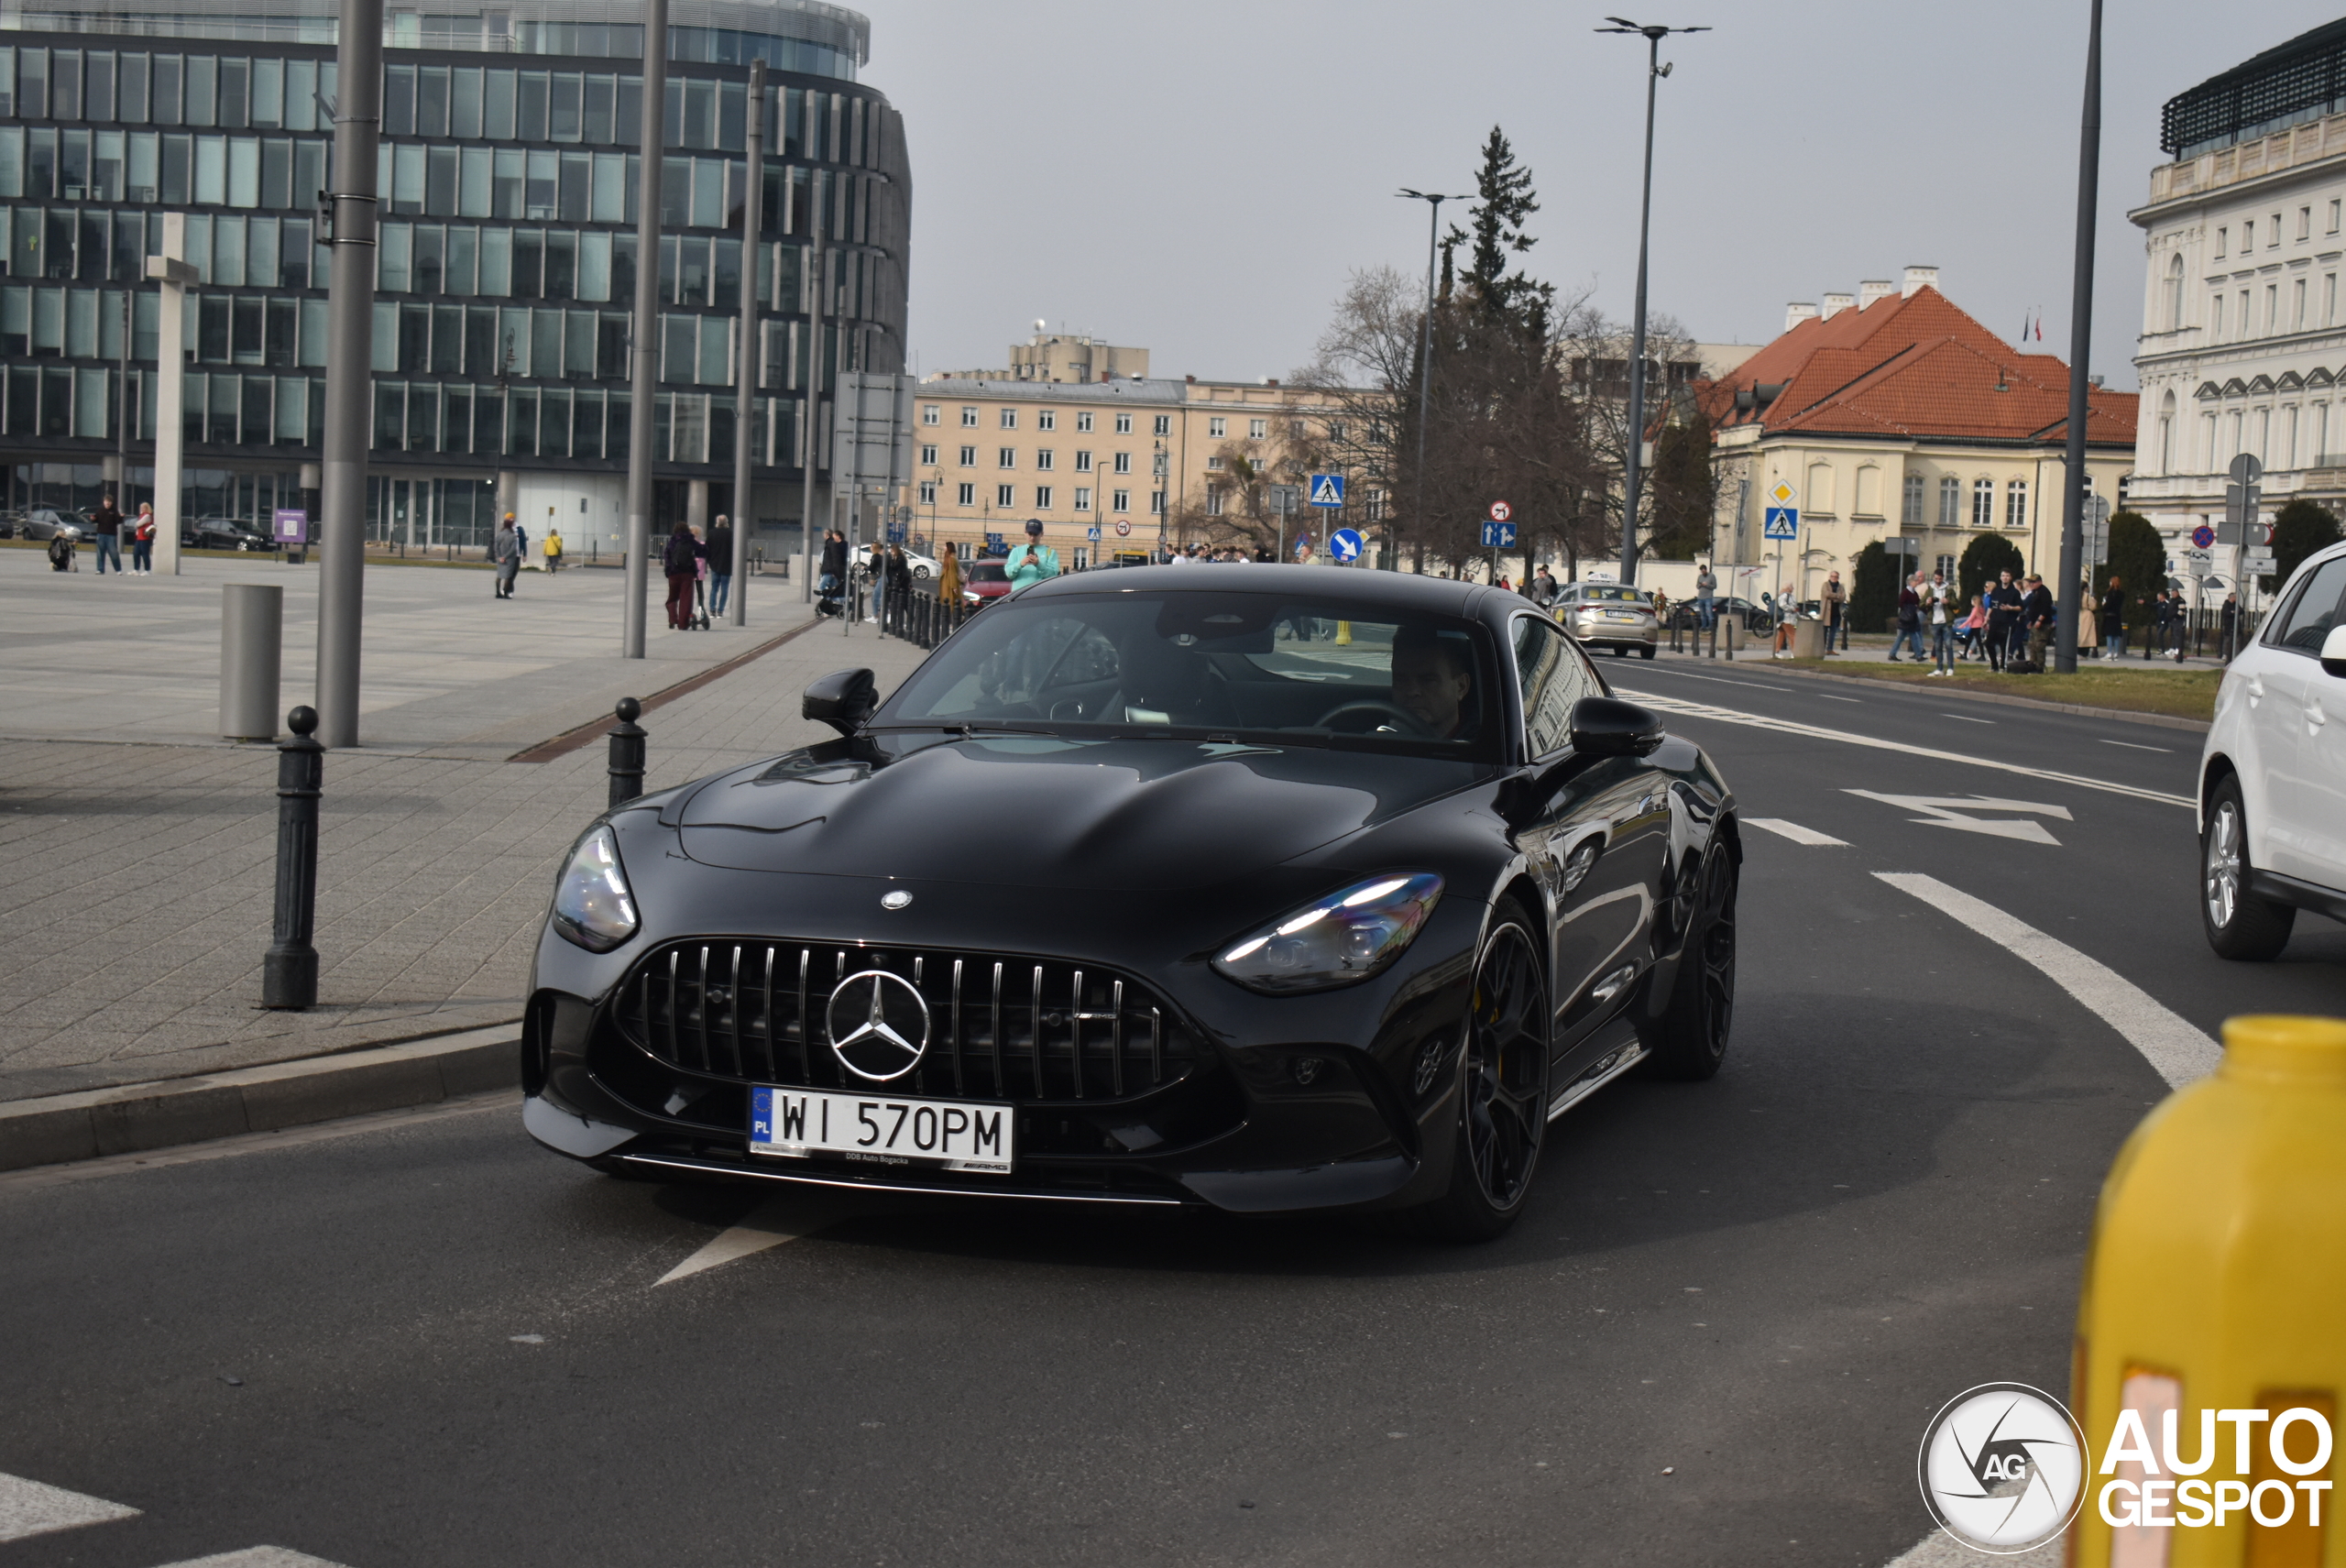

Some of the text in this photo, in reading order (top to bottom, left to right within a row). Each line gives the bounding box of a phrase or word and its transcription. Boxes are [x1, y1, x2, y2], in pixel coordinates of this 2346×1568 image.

[754, 1121, 770, 1135] PL
[783, 1093, 1002, 1157] WI 570PM
[880, 1156, 909, 1165] Bogacka
